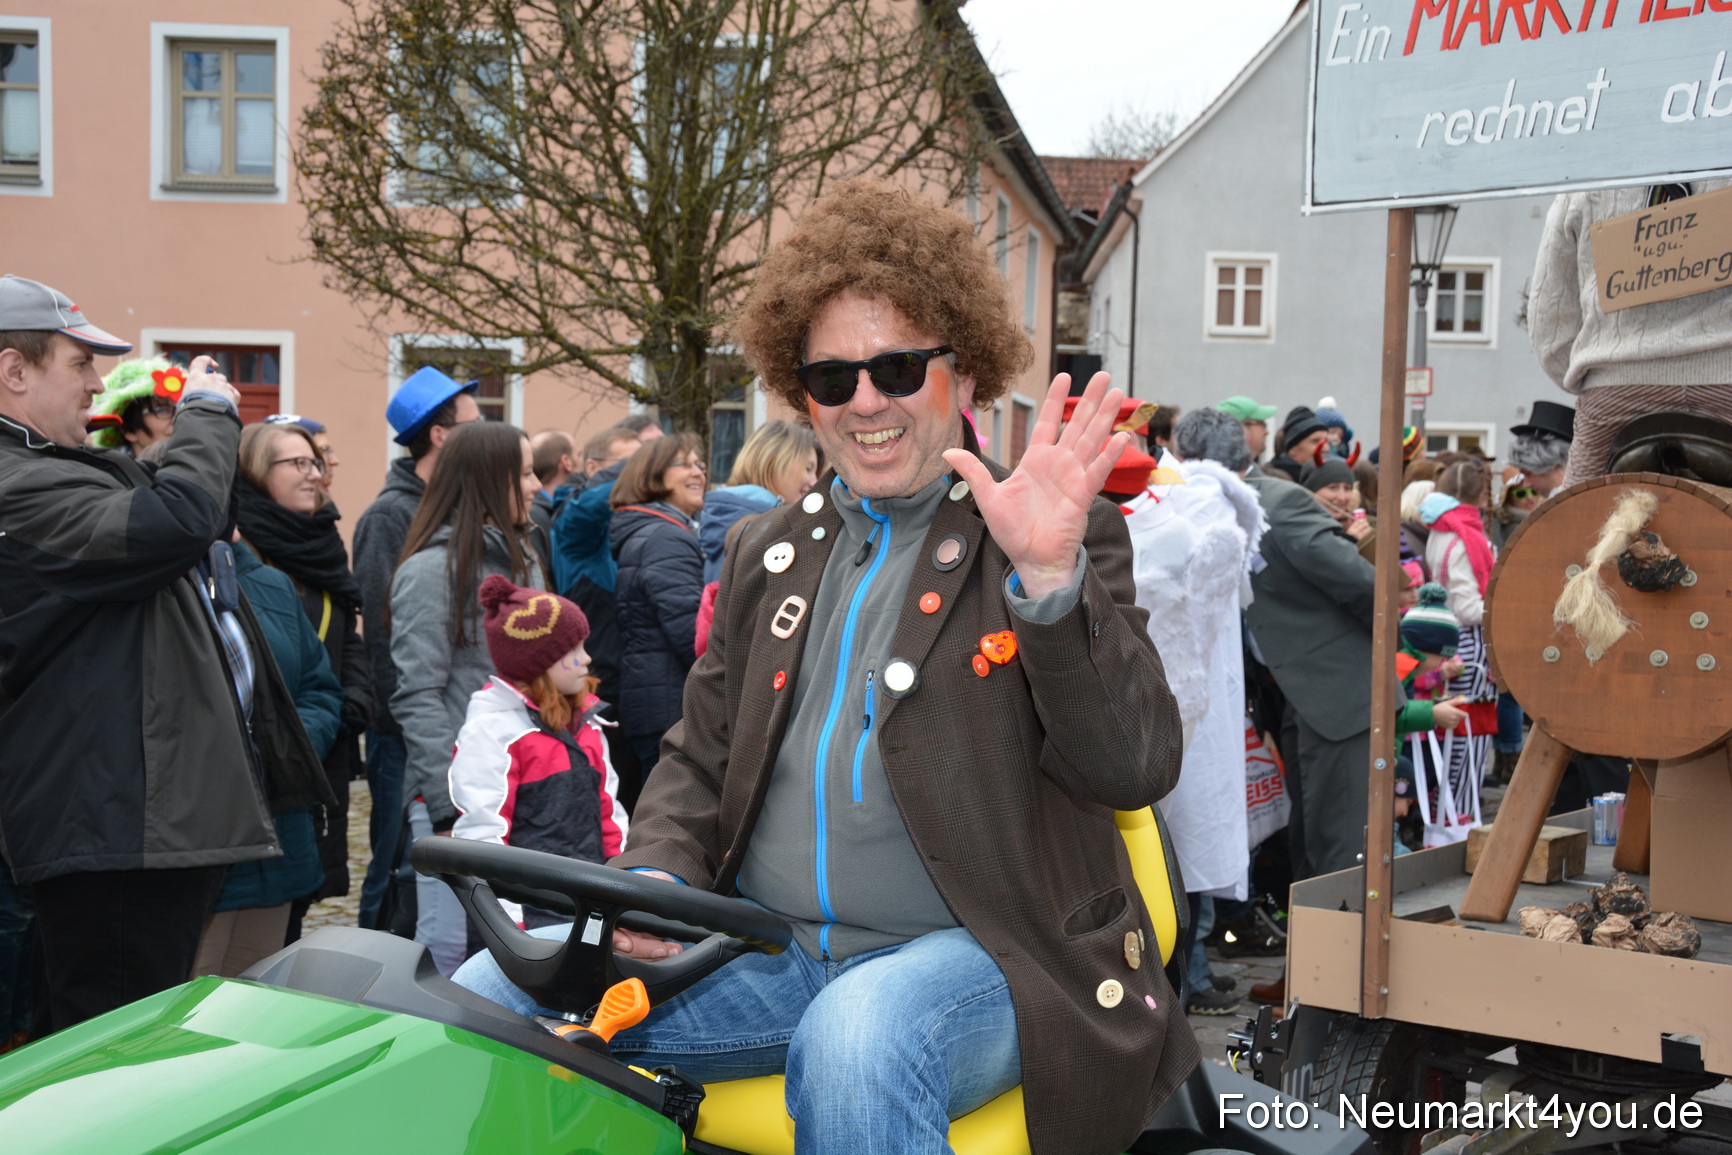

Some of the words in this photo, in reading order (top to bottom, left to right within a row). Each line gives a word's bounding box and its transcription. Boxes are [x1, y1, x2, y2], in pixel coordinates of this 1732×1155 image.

[1325, 3, 1392, 66] Ein
[1416, 67, 1611, 149] rechnet
[1660, 50, 1732, 123] ab
[1634, 212, 1698, 244] Franz
[1606, 251, 1732, 299] Guttenberg
